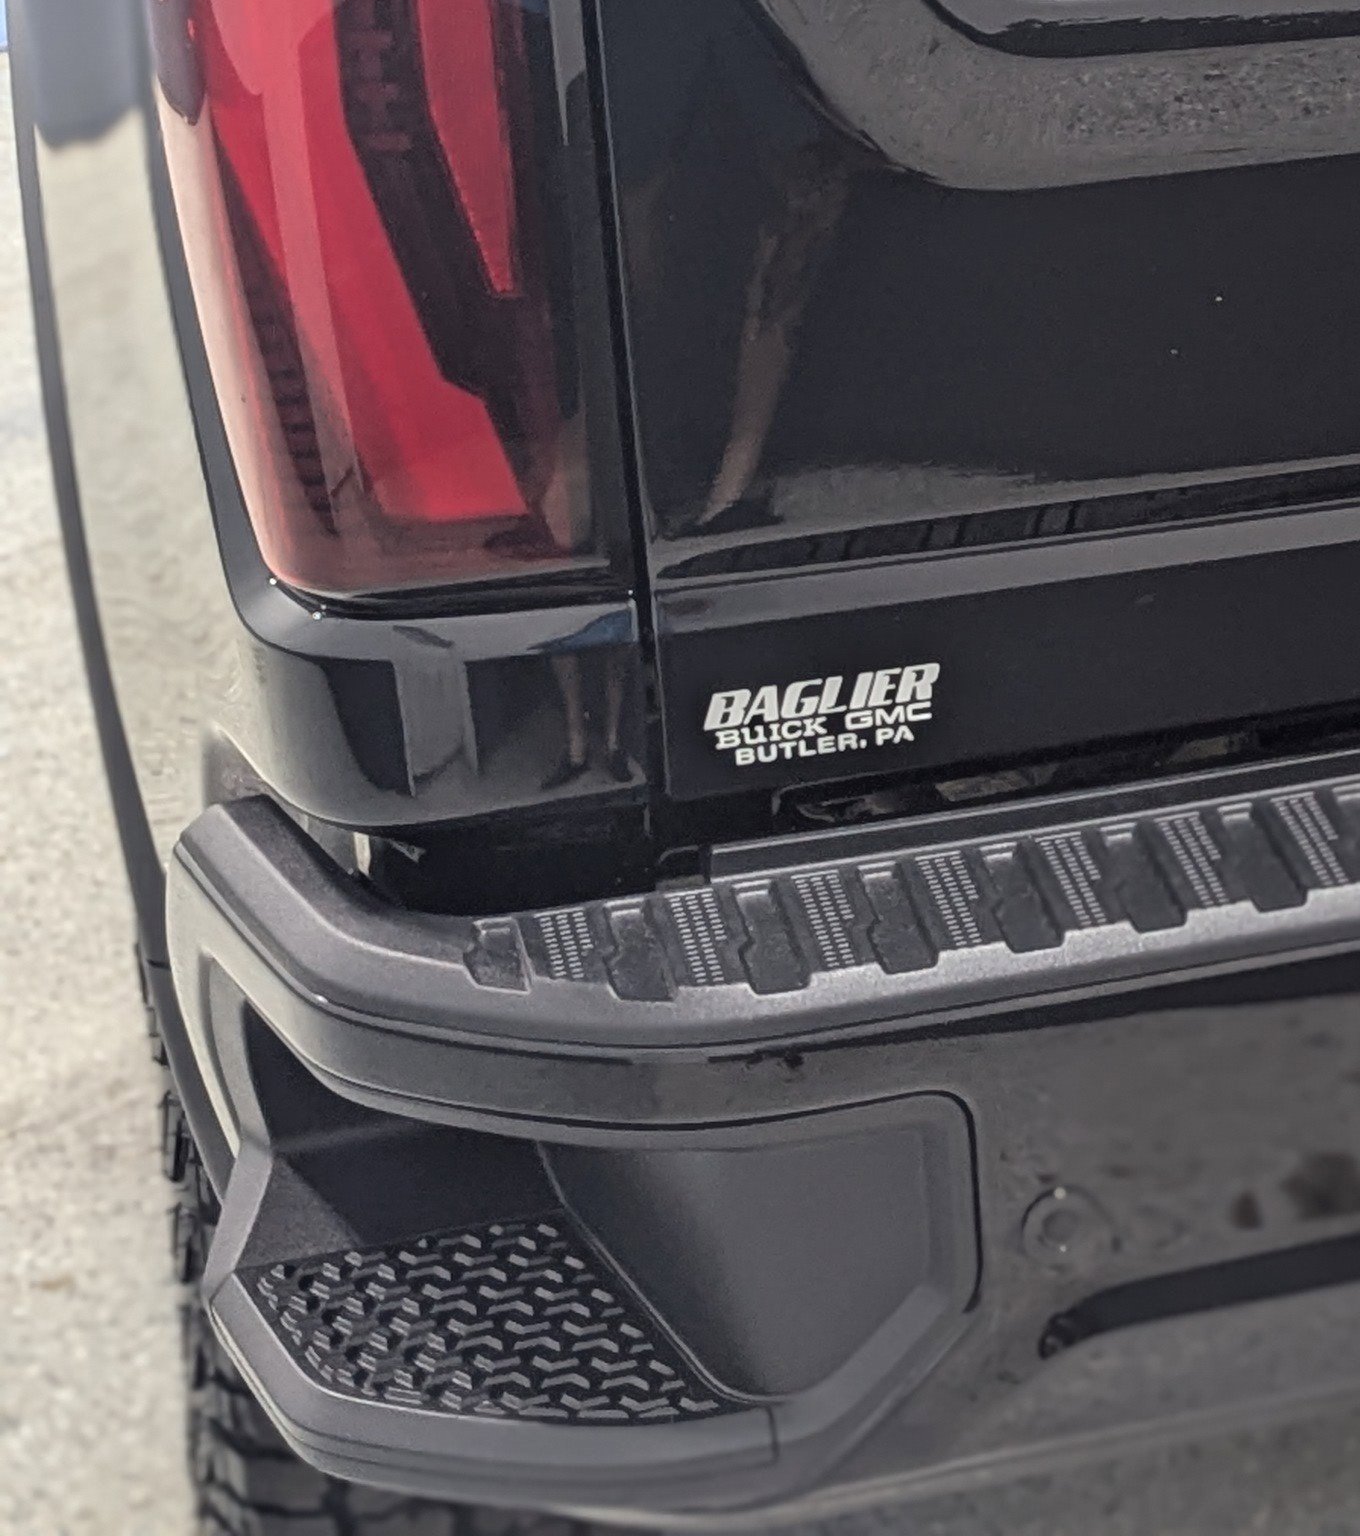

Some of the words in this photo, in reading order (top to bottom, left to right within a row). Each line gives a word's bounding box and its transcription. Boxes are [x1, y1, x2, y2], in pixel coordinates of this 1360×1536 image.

[703, 662, 941, 732] BAGLIER
[714, 715, 828, 751] BUICK
[844, 700, 933, 731] GMC
[875, 724, 915, 747] PA
